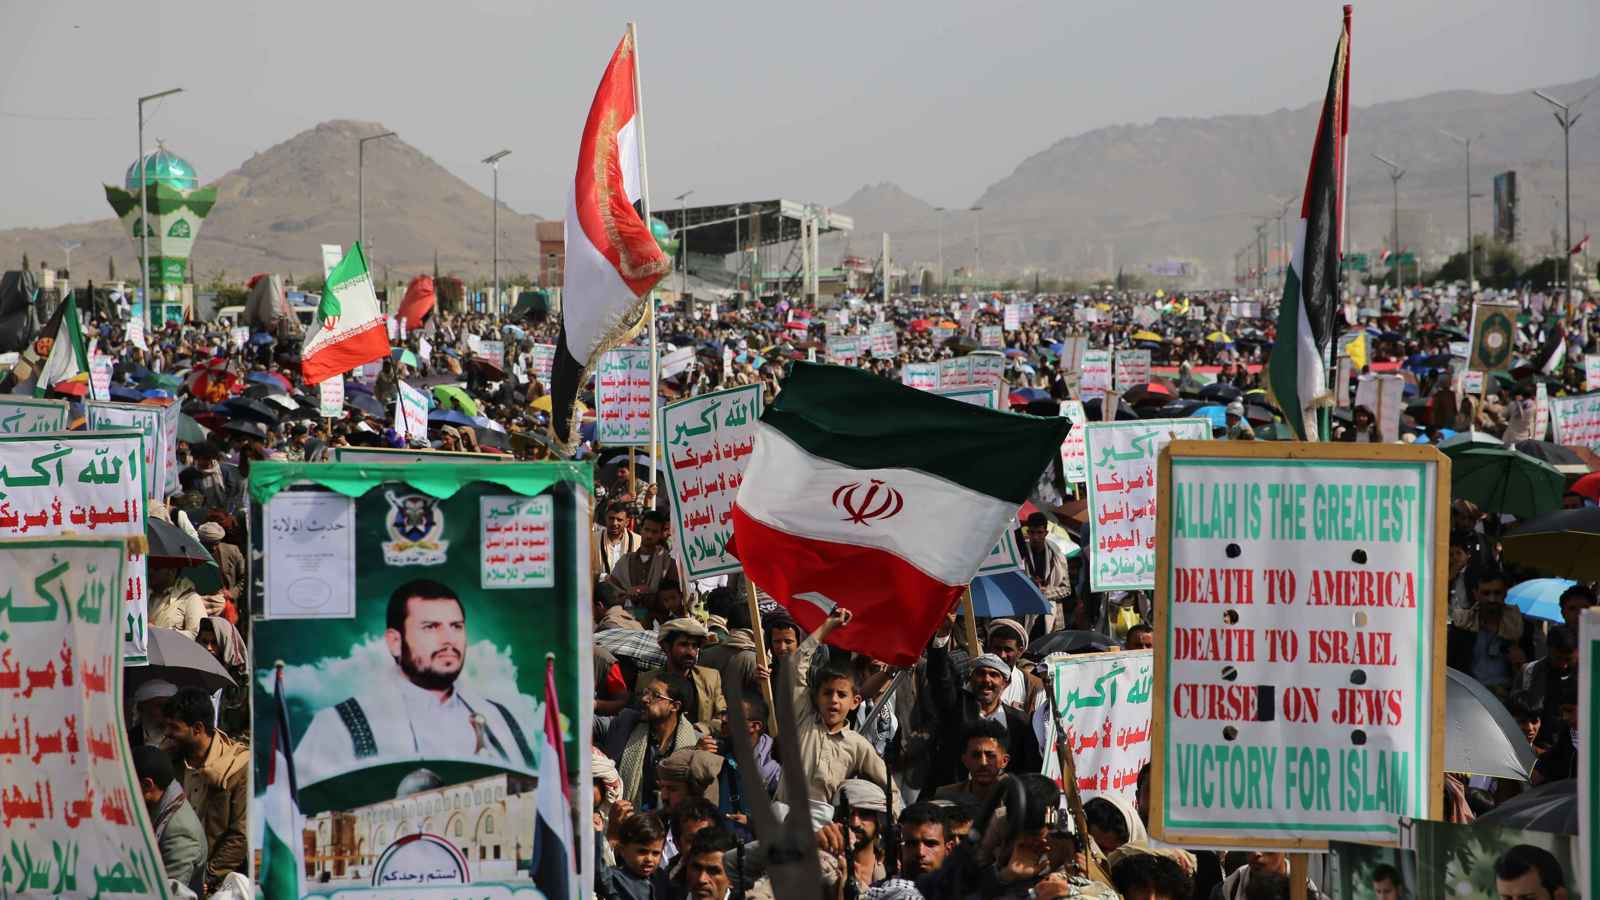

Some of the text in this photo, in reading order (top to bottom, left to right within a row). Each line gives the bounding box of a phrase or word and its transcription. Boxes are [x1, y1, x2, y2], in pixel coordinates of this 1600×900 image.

[670, 398, 721, 447] أكبر
[78, 447, 137, 485] الله
[671, 438, 721, 471] لأمريكا
[1095, 425, 1160, 470] أكبر
[0, 496, 137, 533] الموت لأمريك
[1174, 481, 1417, 543] ALLAH IS THE GREATEST
[1099, 528, 1140, 552] اليهود
[0, 553, 71, 642] أكب
[1174, 567, 1417, 609] DEATH TO AMERICA
[0, 638, 74, 699] لأمريك
[1173, 627, 1398, 666] DEATH TO ISRAEL
[1058, 661, 1127, 722] أكبر
[1283, 685, 1321, 723] ON
[1331, 687, 1403, 726] JEWS
[0, 713, 79, 765] لإسرائي
[1176, 743, 1279, 810] VICTORY
[1284, 745, 1332, 812] FOR
[1339, 748, 1410, 816] ISLAM
[2, 779, 54, 829] اليهو
[426, 868, 457, 883] لستم
